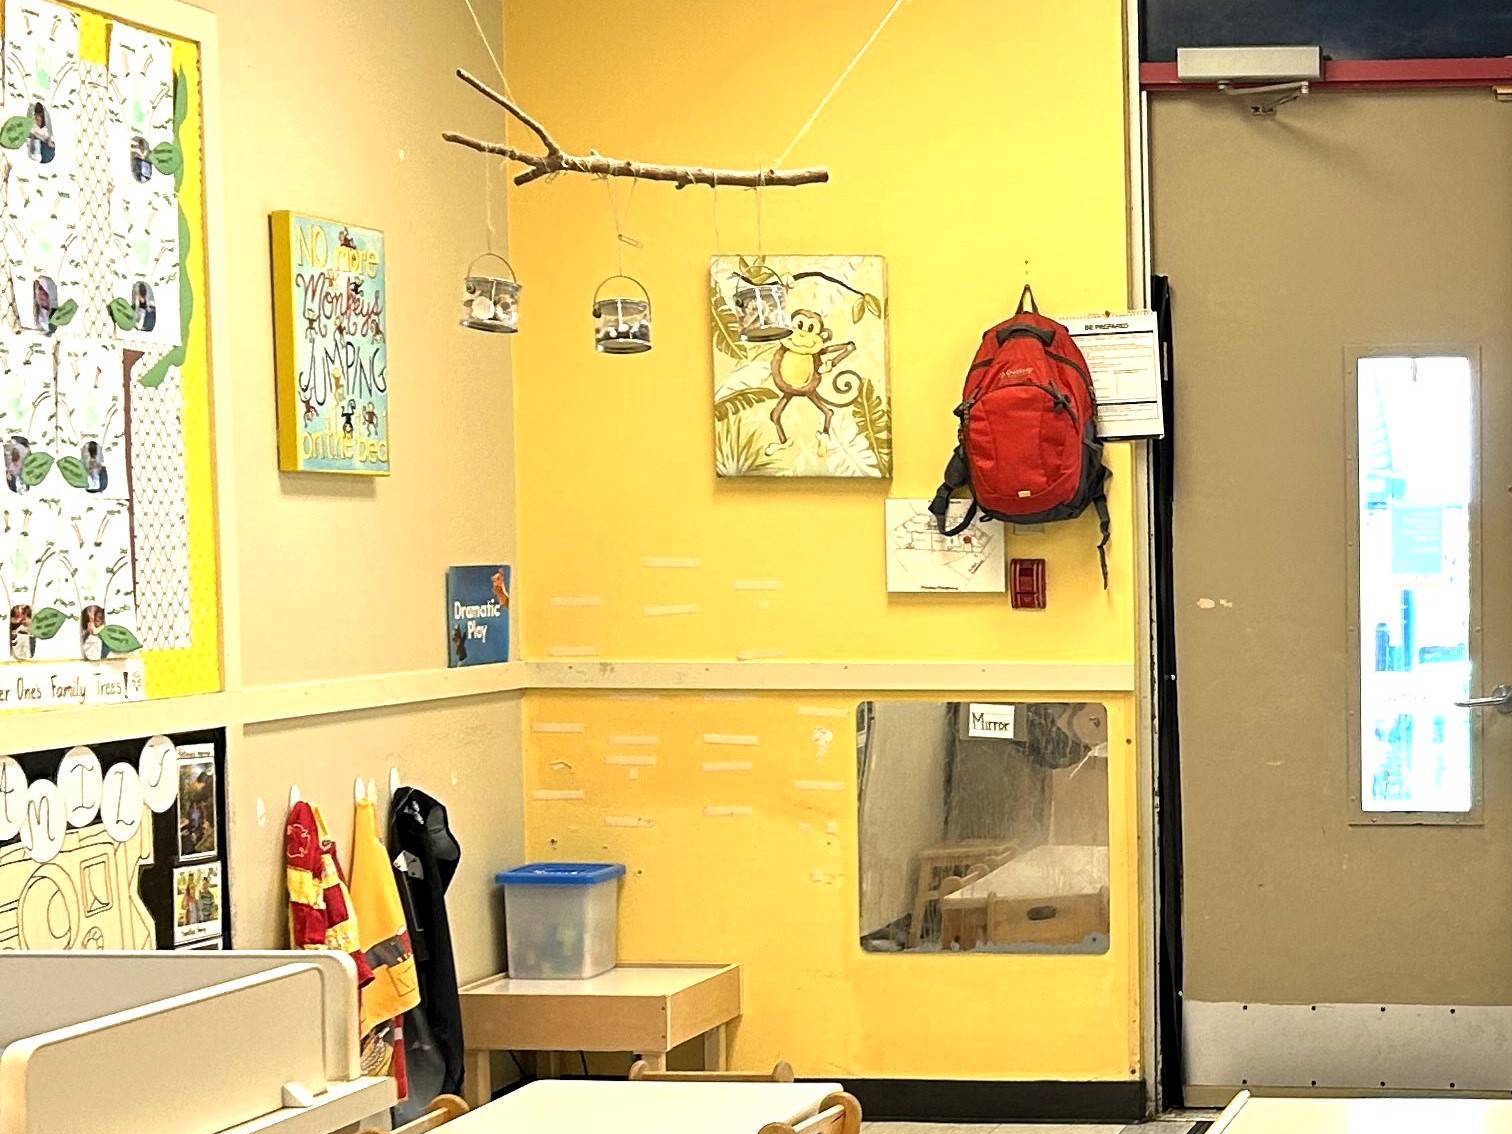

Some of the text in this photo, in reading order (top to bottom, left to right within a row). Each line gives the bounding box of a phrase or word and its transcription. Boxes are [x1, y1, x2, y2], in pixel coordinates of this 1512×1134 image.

[297, 223, 328, 268] NO
[296, 271, 383, 338] Monkeys
[1095, 322, 1129, 330] PREPARED
[299, 337, 387, 406] JUMPING
[454, 598, 501, 620] Dramatic
[467, 620, 488, 644] Play
[51, 675, 86, 704] Family
[972, 711, 1011, 731] Mirror
